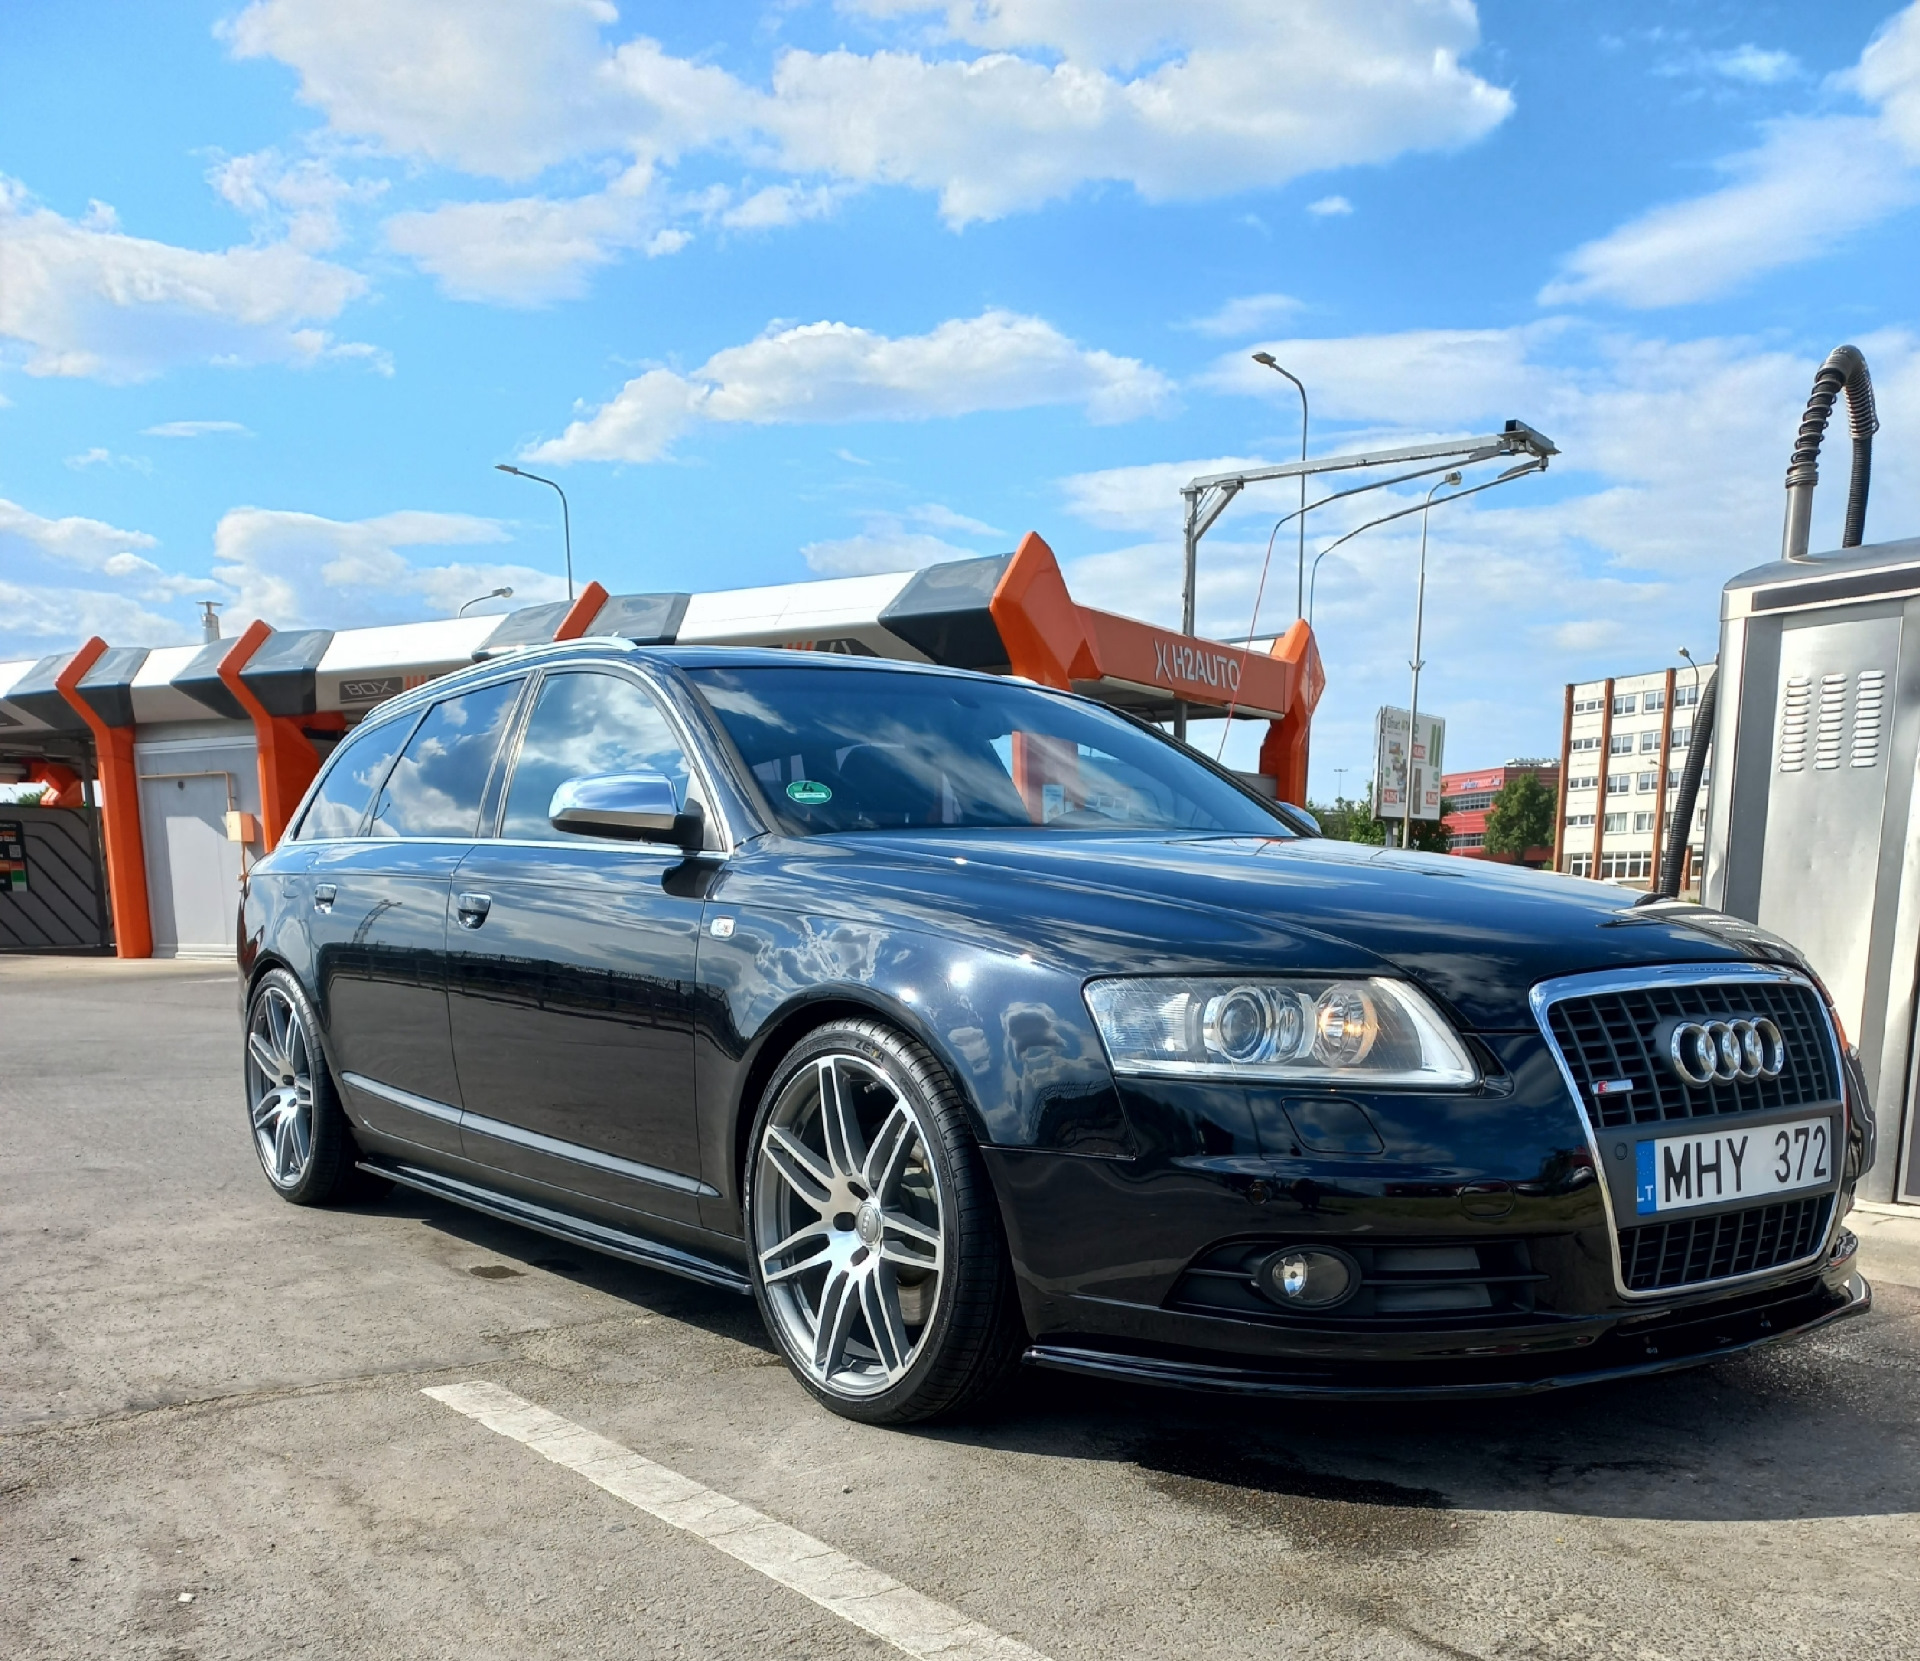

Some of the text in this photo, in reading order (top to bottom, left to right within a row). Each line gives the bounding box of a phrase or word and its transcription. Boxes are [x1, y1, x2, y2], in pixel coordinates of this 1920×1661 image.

[1172, 644, 1240, 691] H2AUTO
[344, 680, 396, 696] BOX
[1663, 1125, 1827, 1203] MHY 372
[1636, 1185, 1654, 1203] LT
